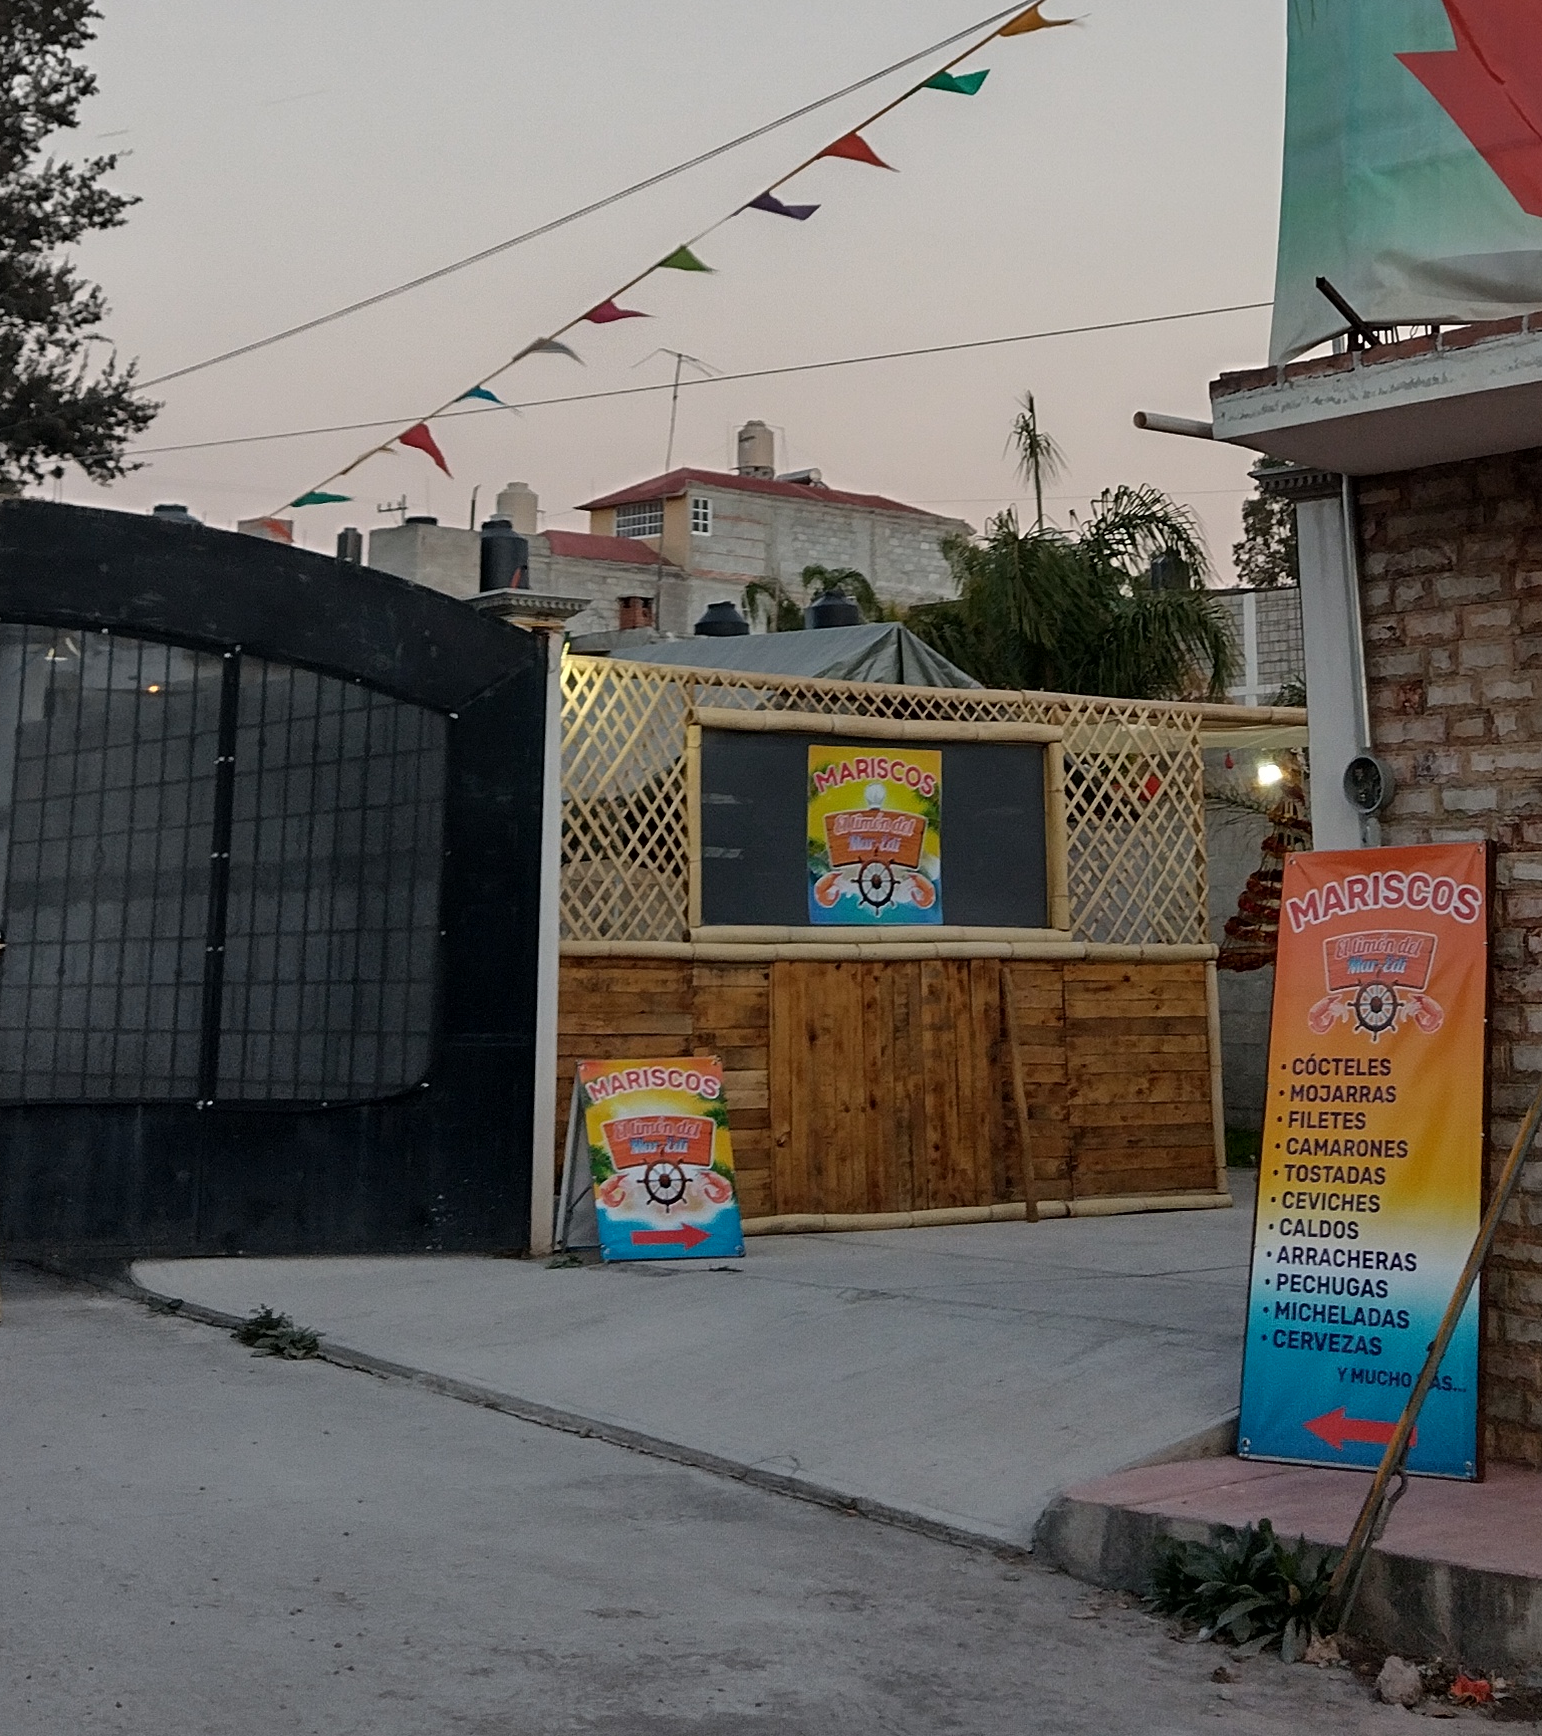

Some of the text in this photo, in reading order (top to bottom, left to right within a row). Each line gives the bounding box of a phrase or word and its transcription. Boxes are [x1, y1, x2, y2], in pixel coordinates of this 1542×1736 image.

[814, 757, 936, 796] MARISCOS
[1287, 871, 1482, 932] MARISCOS
[1291, 1053, 1392, 1076] CÓCTELES
[586, 1067, 720, 1102] MARISCOS
[1289, 1084, 1397, 1103] MOJARRAS
[1287, 1111, 1367, 1130] FILETES
[1285, 1137, 1408, 1158] CAMARONES
[1284, 1164, 1386, 1185] TOSTADAS
[1281, 1191, 1381, 1213] CEVICHES
[1279, 1218, 1359, 1240] CALDOS
[1276, 1245, 1418, 1272] ARRACHERAS
[1276, 1273, 1389, 1298] PECHUGAS
[1274, 1301, 1410, 1329] MICHELADAS
[1272, 1328, 1383, 1356] CERVEZAS
[1337, 1367, 1348, 1383] Y
[1351, 1367, 1412, 1387] MUCHO
